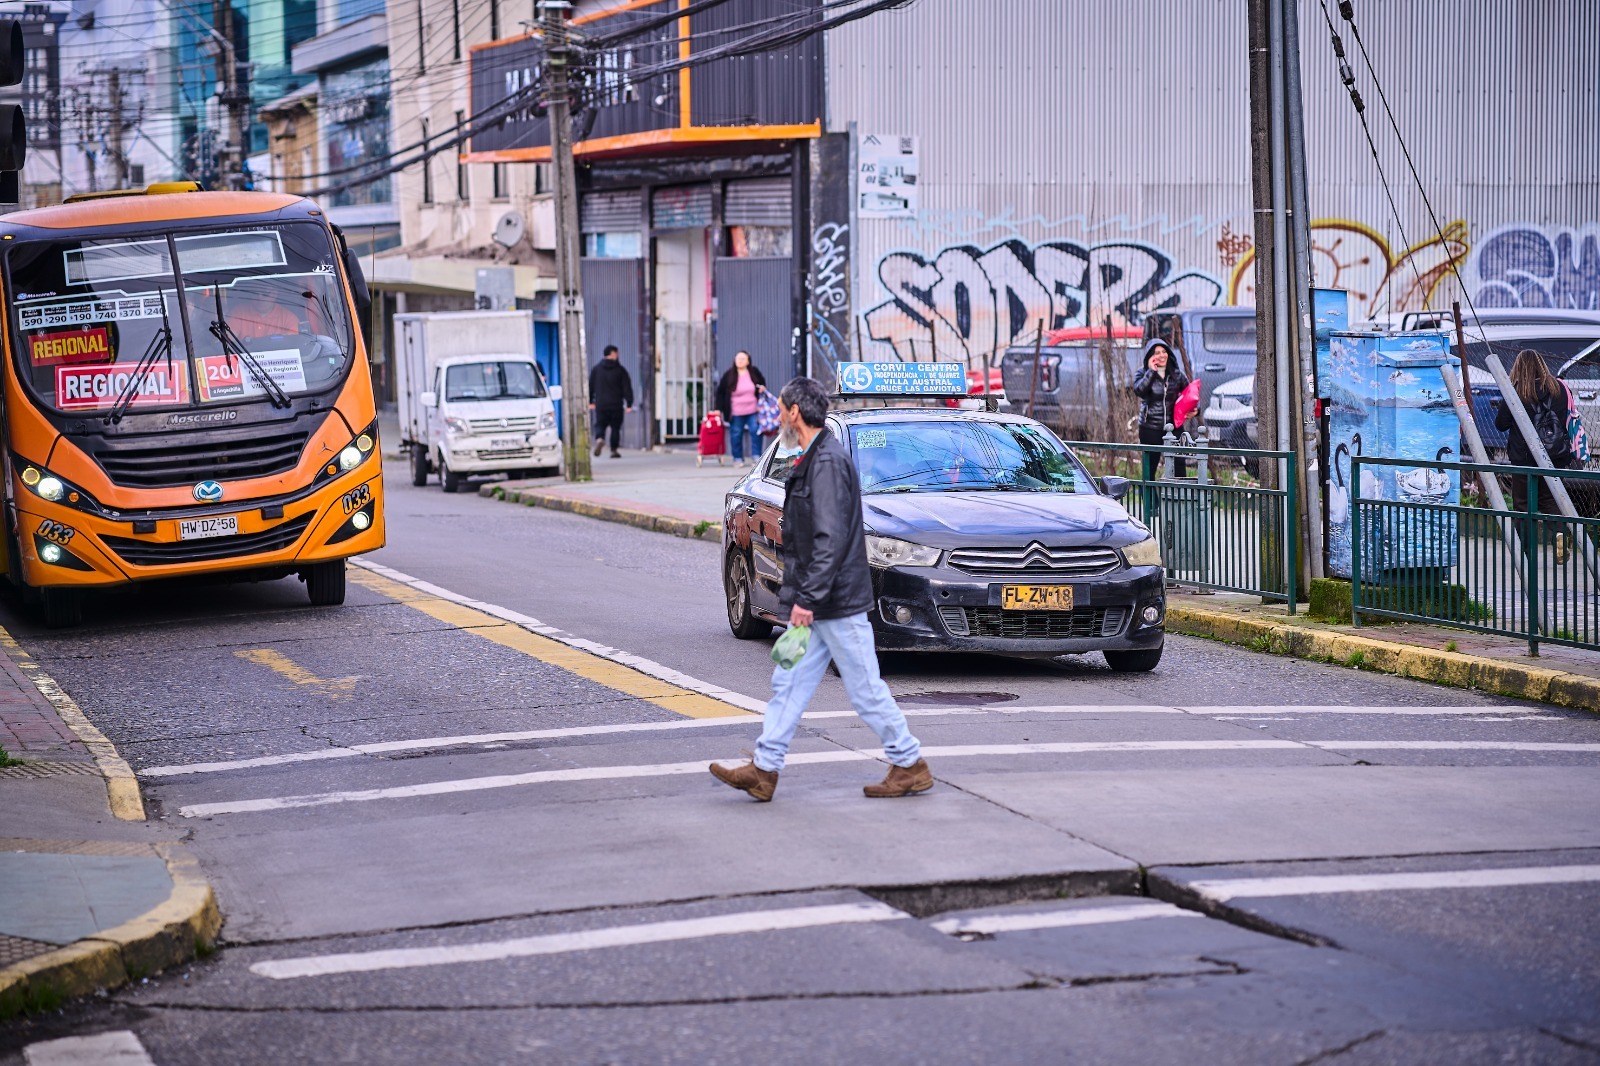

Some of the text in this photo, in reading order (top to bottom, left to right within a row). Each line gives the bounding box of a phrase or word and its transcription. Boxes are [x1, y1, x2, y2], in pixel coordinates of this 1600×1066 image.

[33, 334, 108, 359] REGIONAL
[845, 368, 869, 387] 45
[873, 363, 960, 372] CORVI CENTRO
[65, 372, 172, 399] REGIONAL
[912, 378, 953, 386] AUSTRAL
[168, 410, 237, 425] Mascarello
[342, 484, 370, 515] 033
[37, 520, 75, 545] 033
